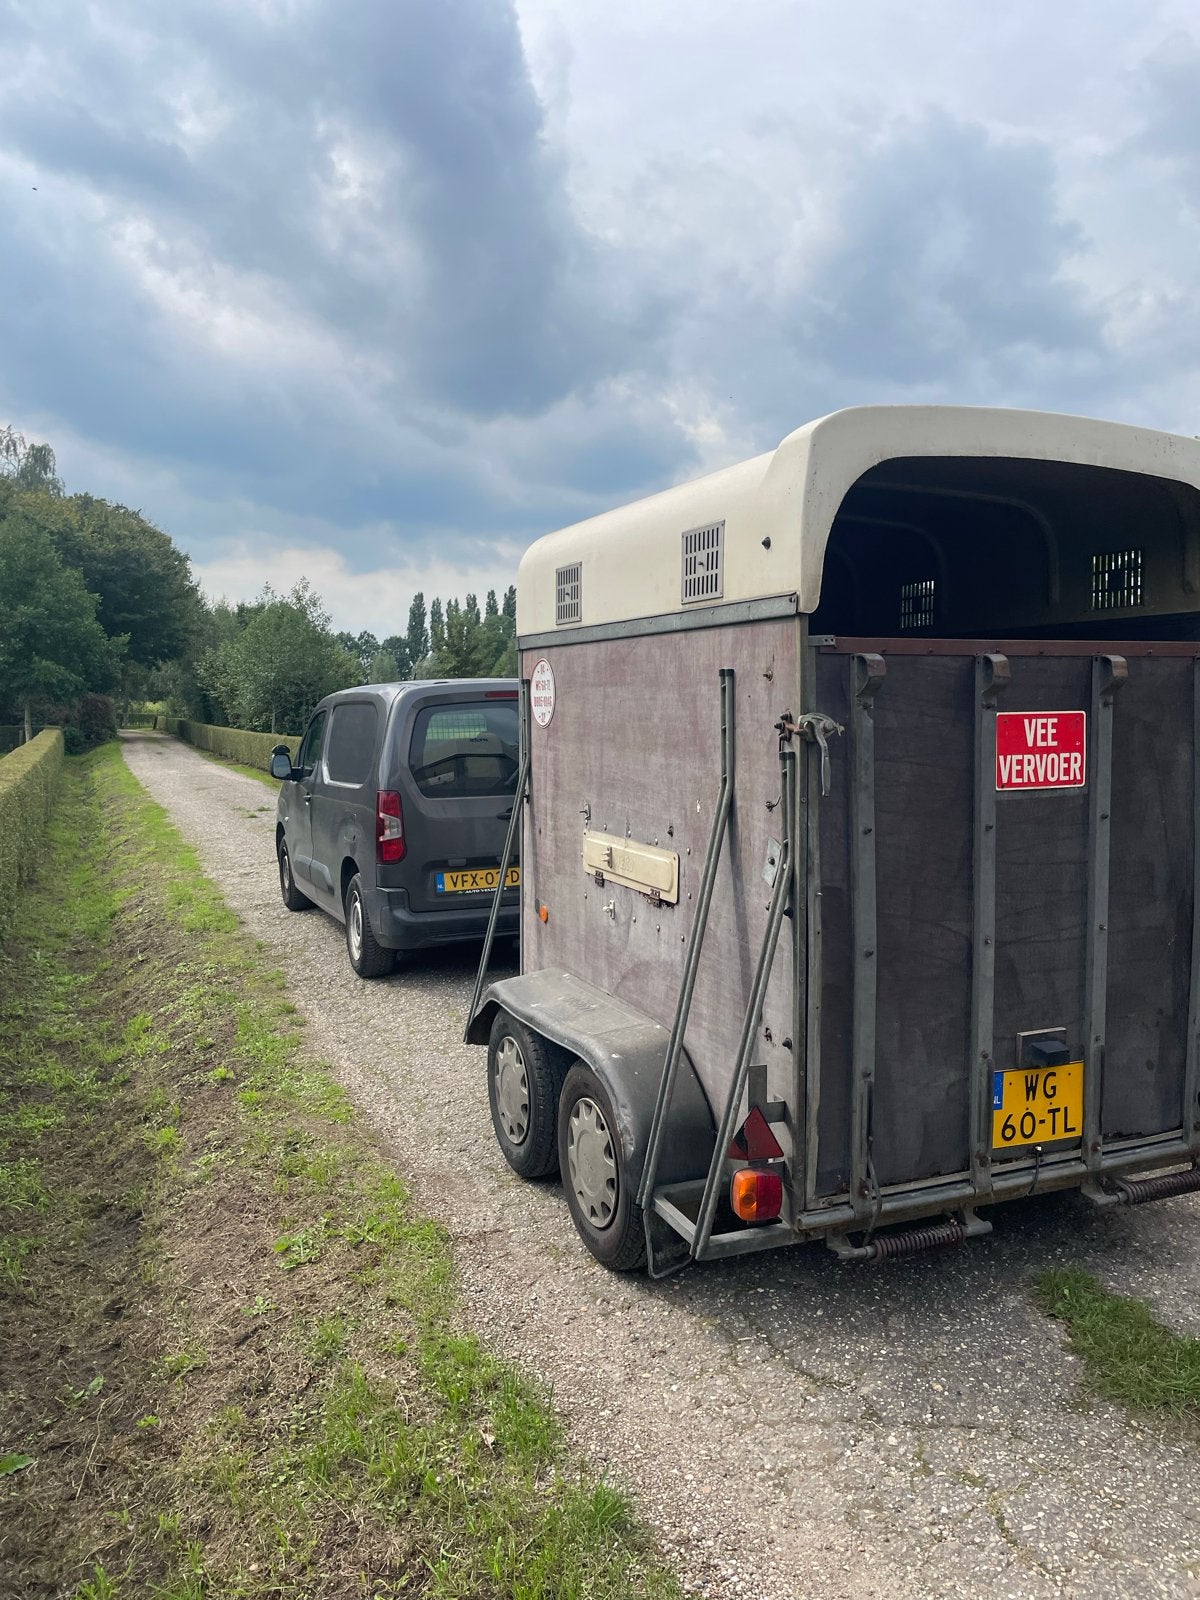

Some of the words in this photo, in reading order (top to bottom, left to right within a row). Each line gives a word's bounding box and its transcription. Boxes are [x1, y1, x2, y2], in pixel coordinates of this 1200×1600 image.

[1023, 718, 1058, 748] VEE
[998, 752, 1082, 784] VERVOER
[1024, 1071, 1057, 1102] WG
[1001, 1106, 1076, 1142] 60-TL
